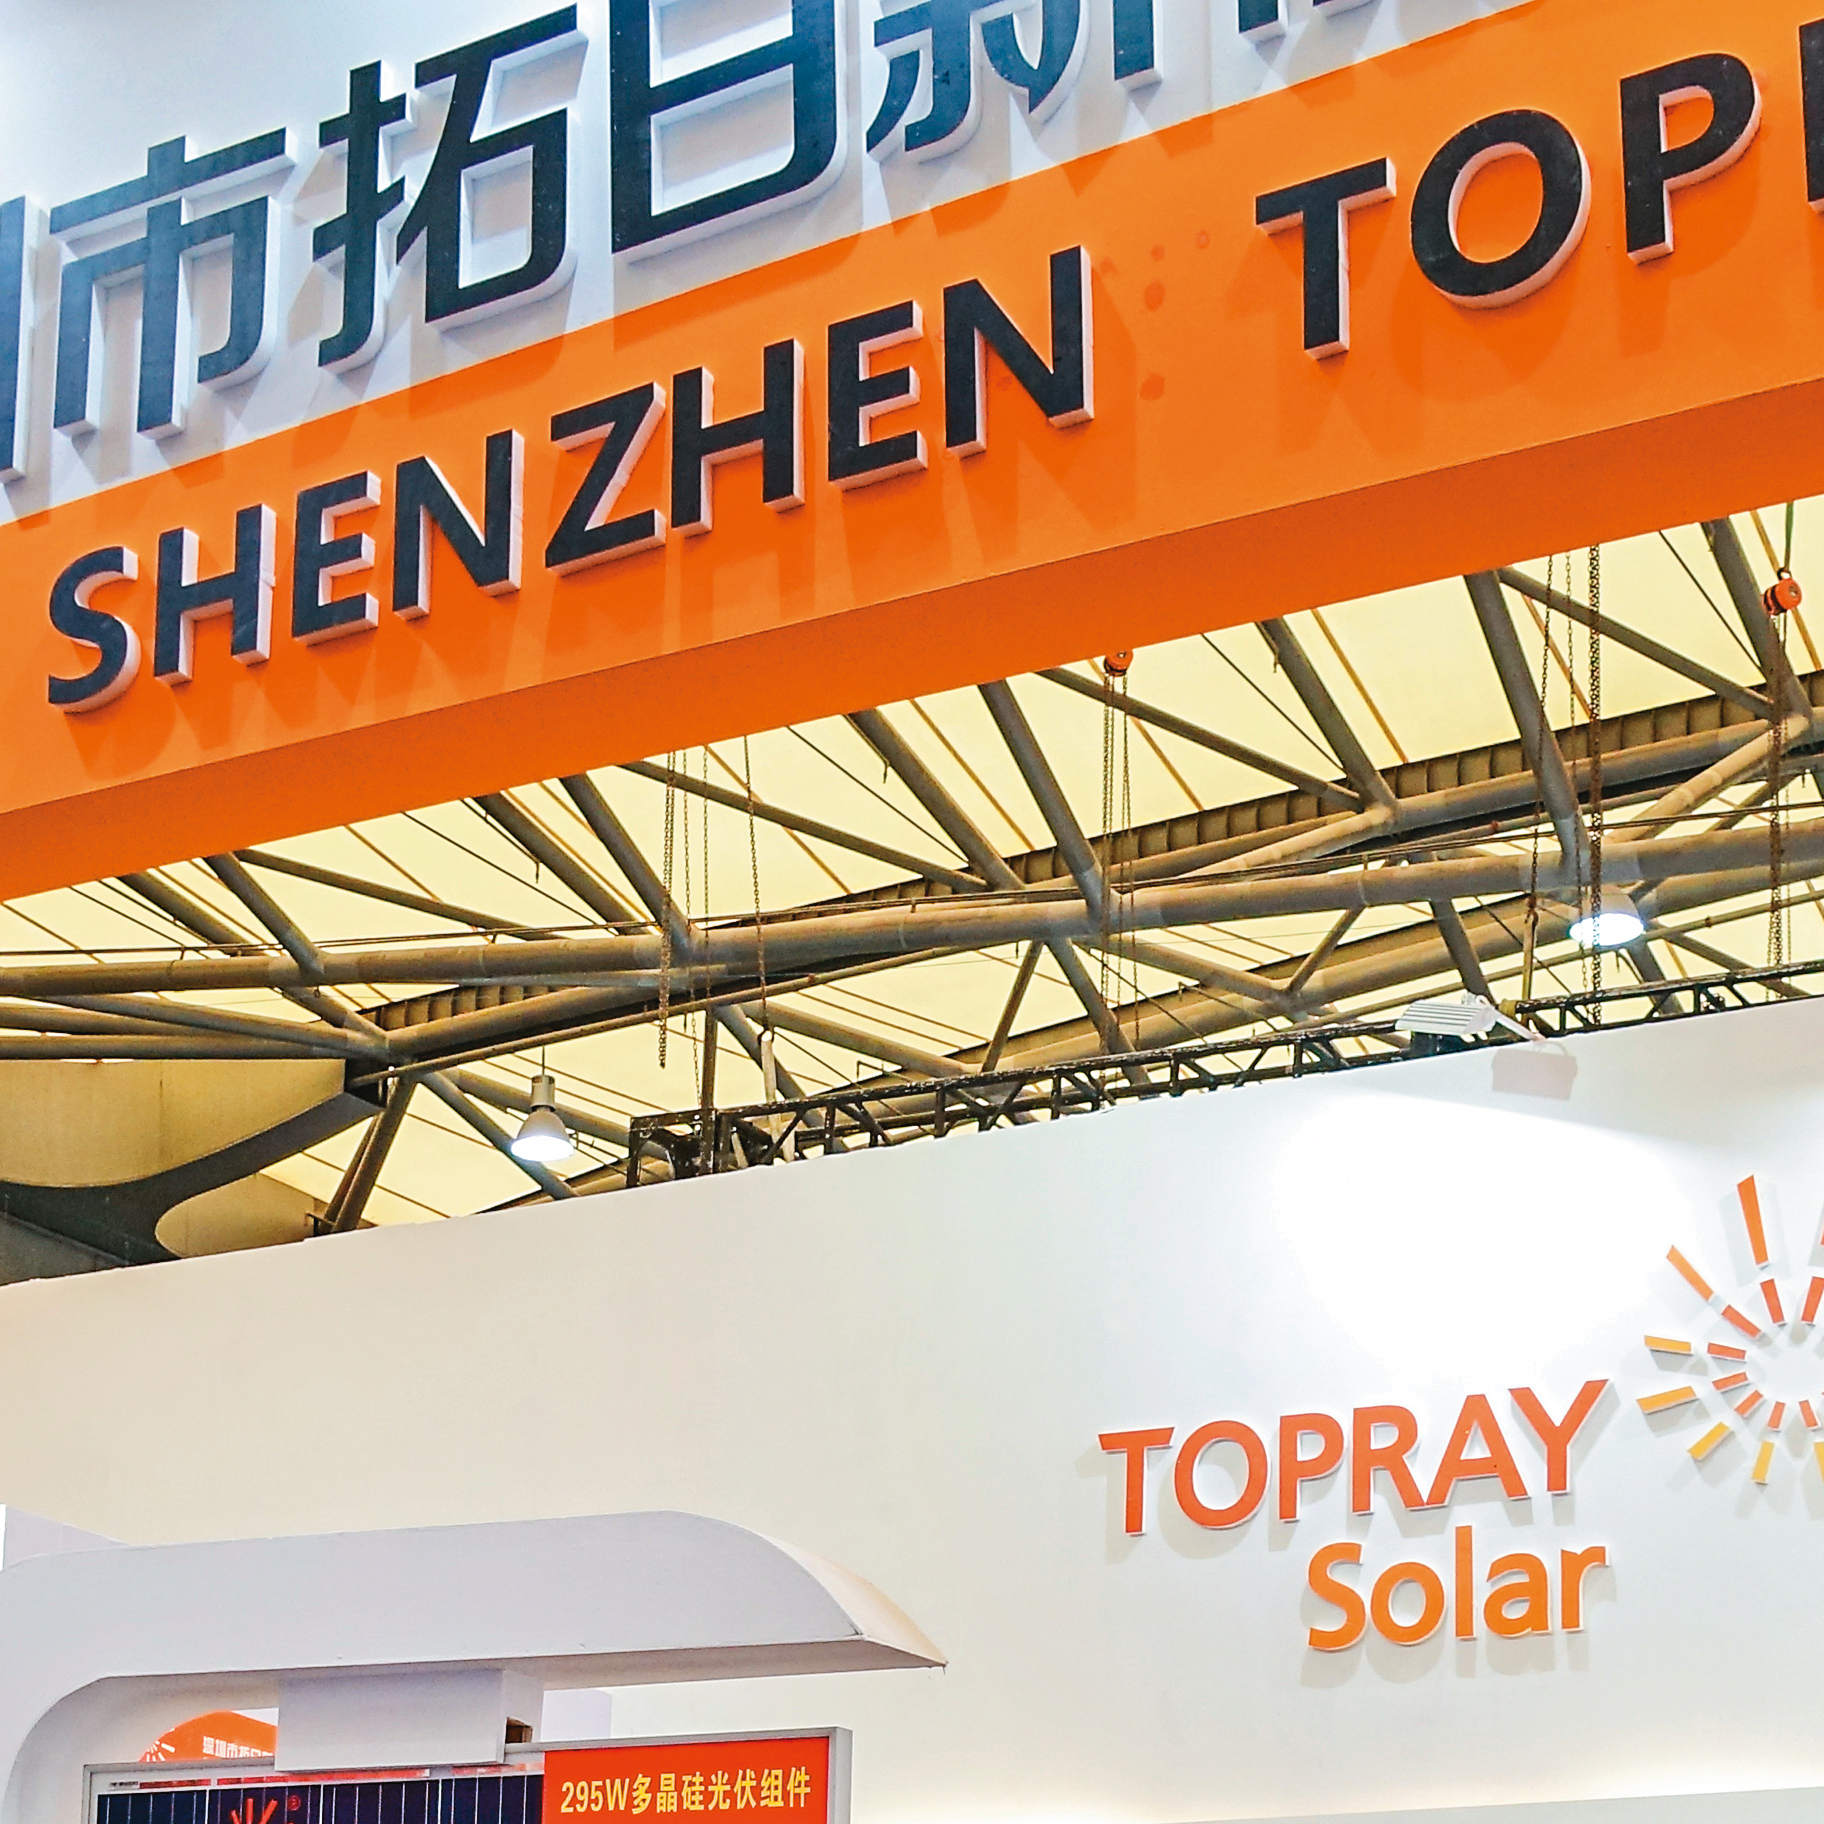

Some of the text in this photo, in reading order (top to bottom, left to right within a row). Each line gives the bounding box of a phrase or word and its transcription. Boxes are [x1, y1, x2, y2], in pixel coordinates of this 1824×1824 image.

[47, 246, 1095, 712] SHENZHEN
[1098, 1379, 1608, 1533] TOPRAY
[1307, 1525, 1608, 1650] Solar
[560, 1764, 812, 1815] 295W多晶硅光伏组件
